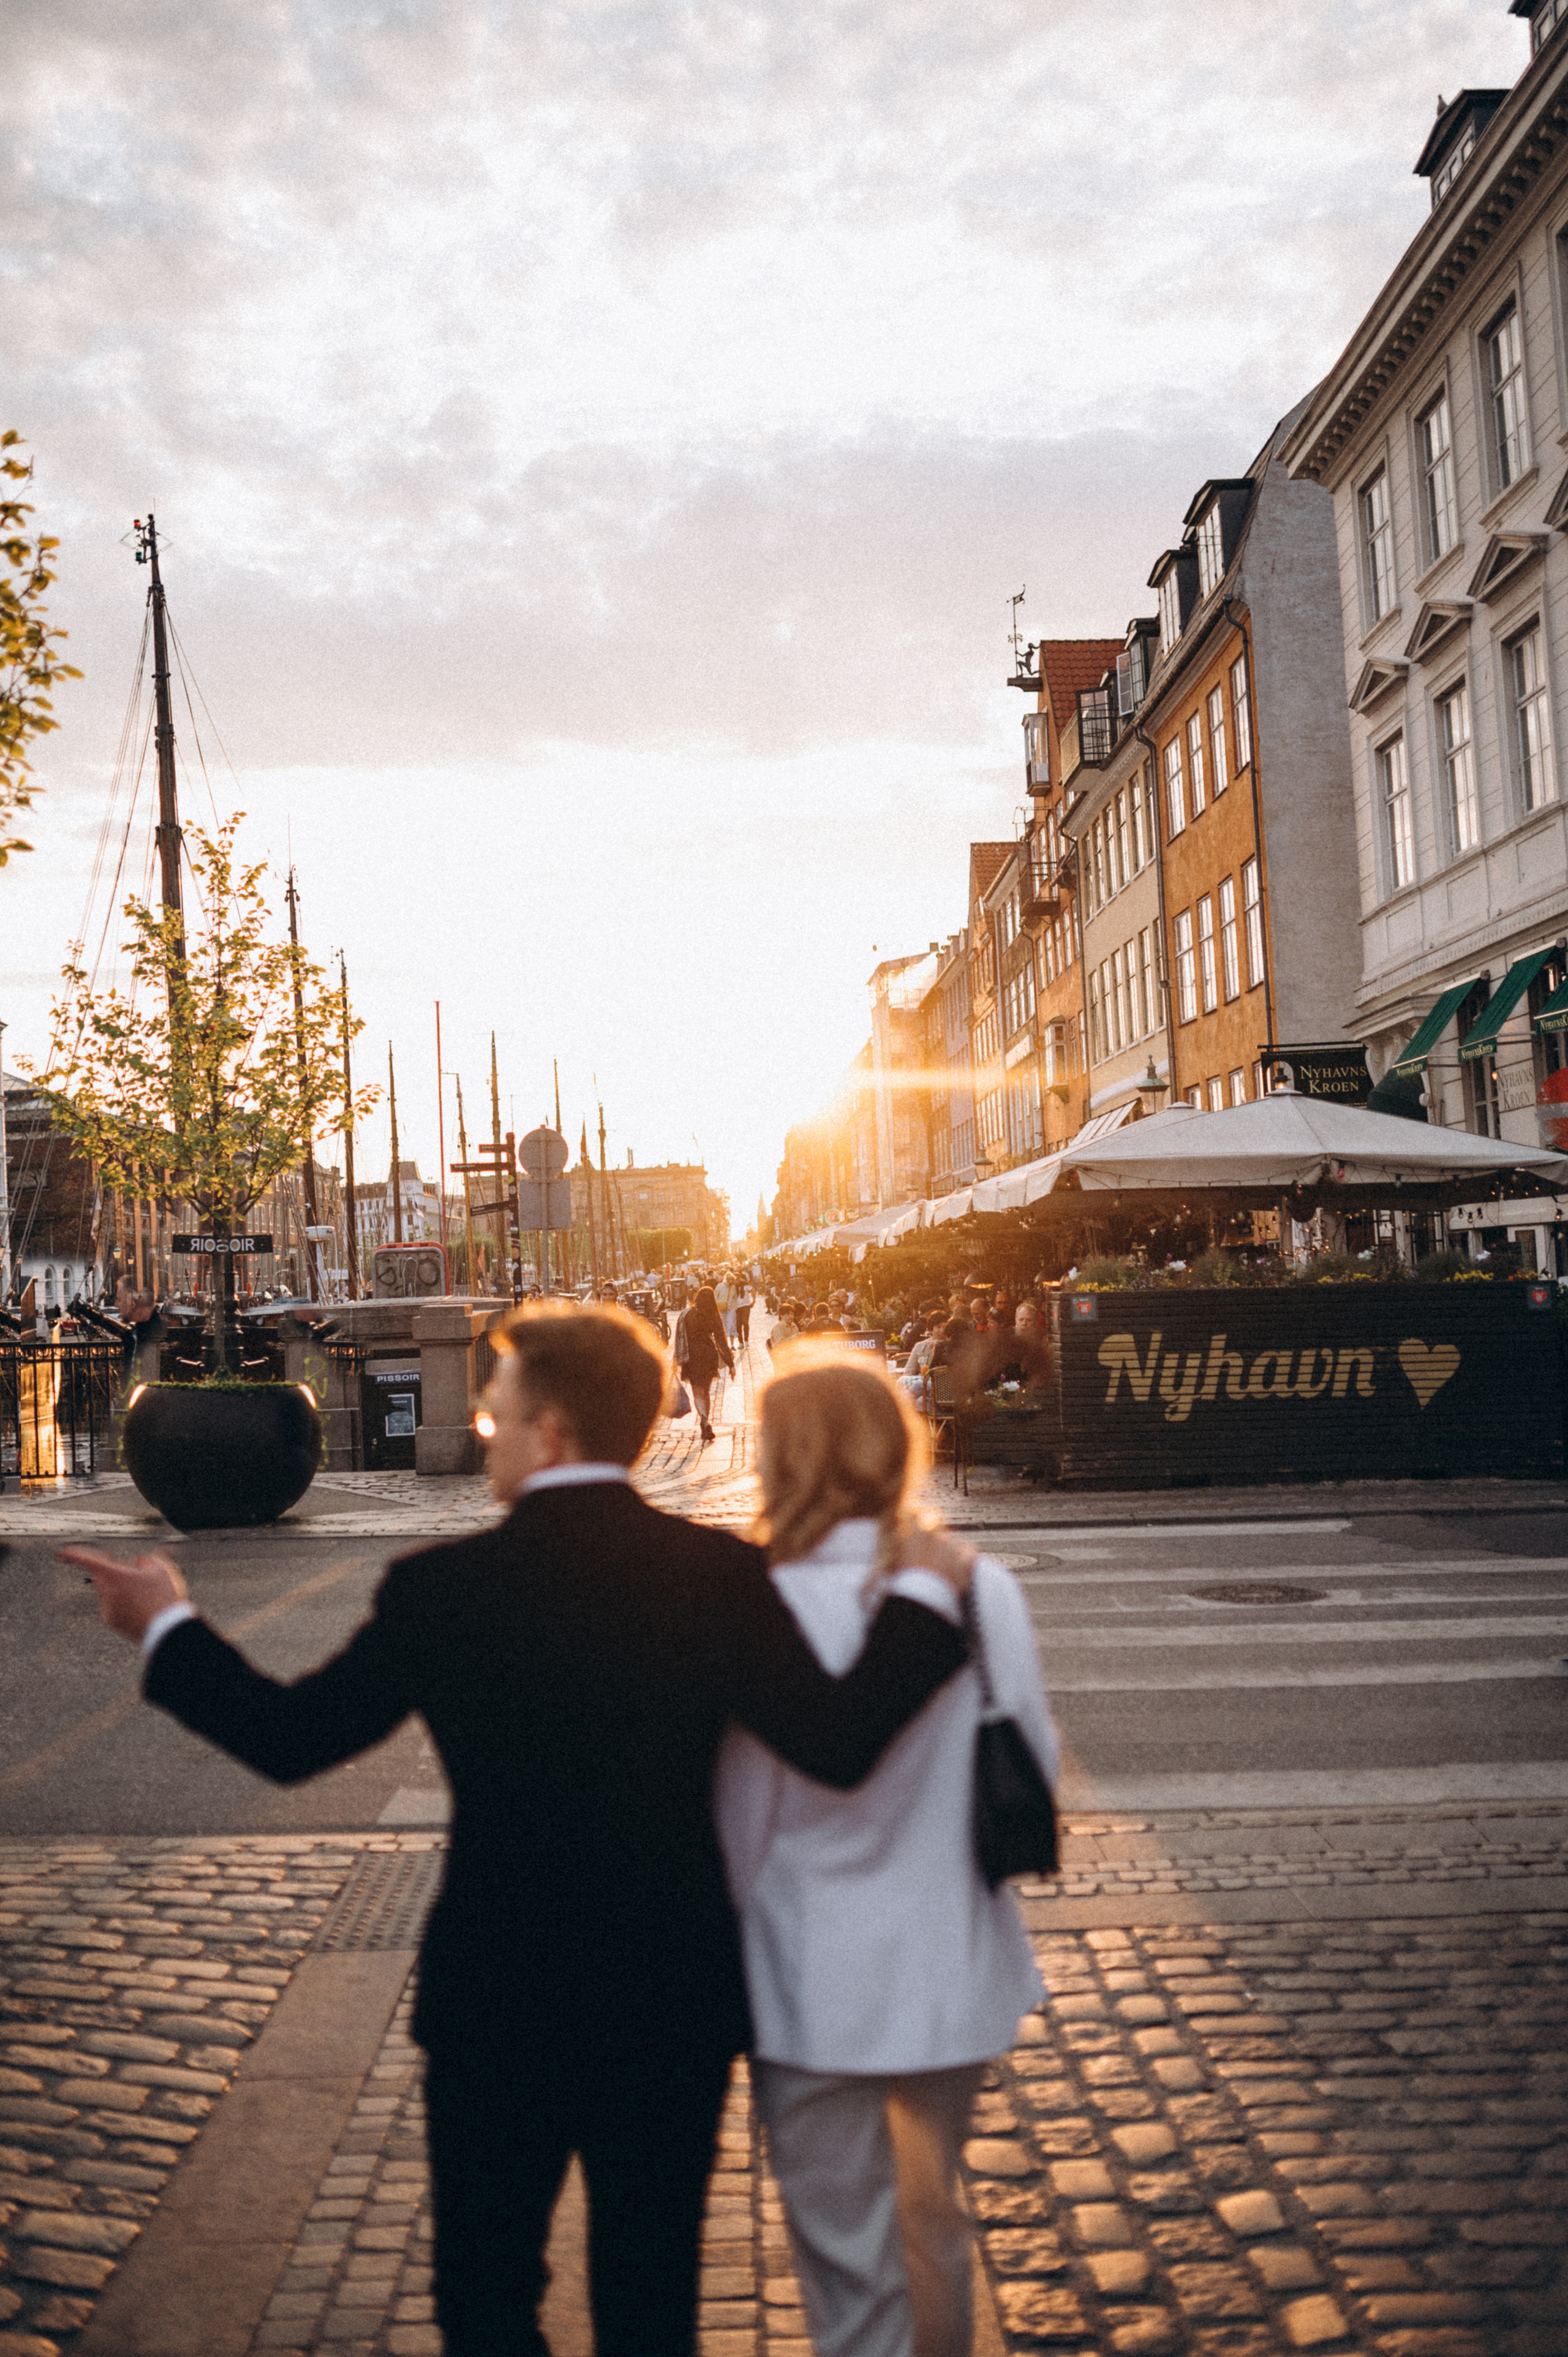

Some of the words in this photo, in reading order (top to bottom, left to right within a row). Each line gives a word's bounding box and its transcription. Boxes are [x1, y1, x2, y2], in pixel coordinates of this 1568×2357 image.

[1300, 1065, 1367, 1079] NYHAVNS
[1498, 1067, 1534, 1091] NYHAVNS
[1309, 1080, 1359, 1094] KROEN
[1503, 1091, 1530, 1110] KROEN
[833, 1339, 876, 1350] TUBORG
[377, 1374, 420, 1382] PISSOIR
[1098, 1331, 1376, 1421] Nyhavn
